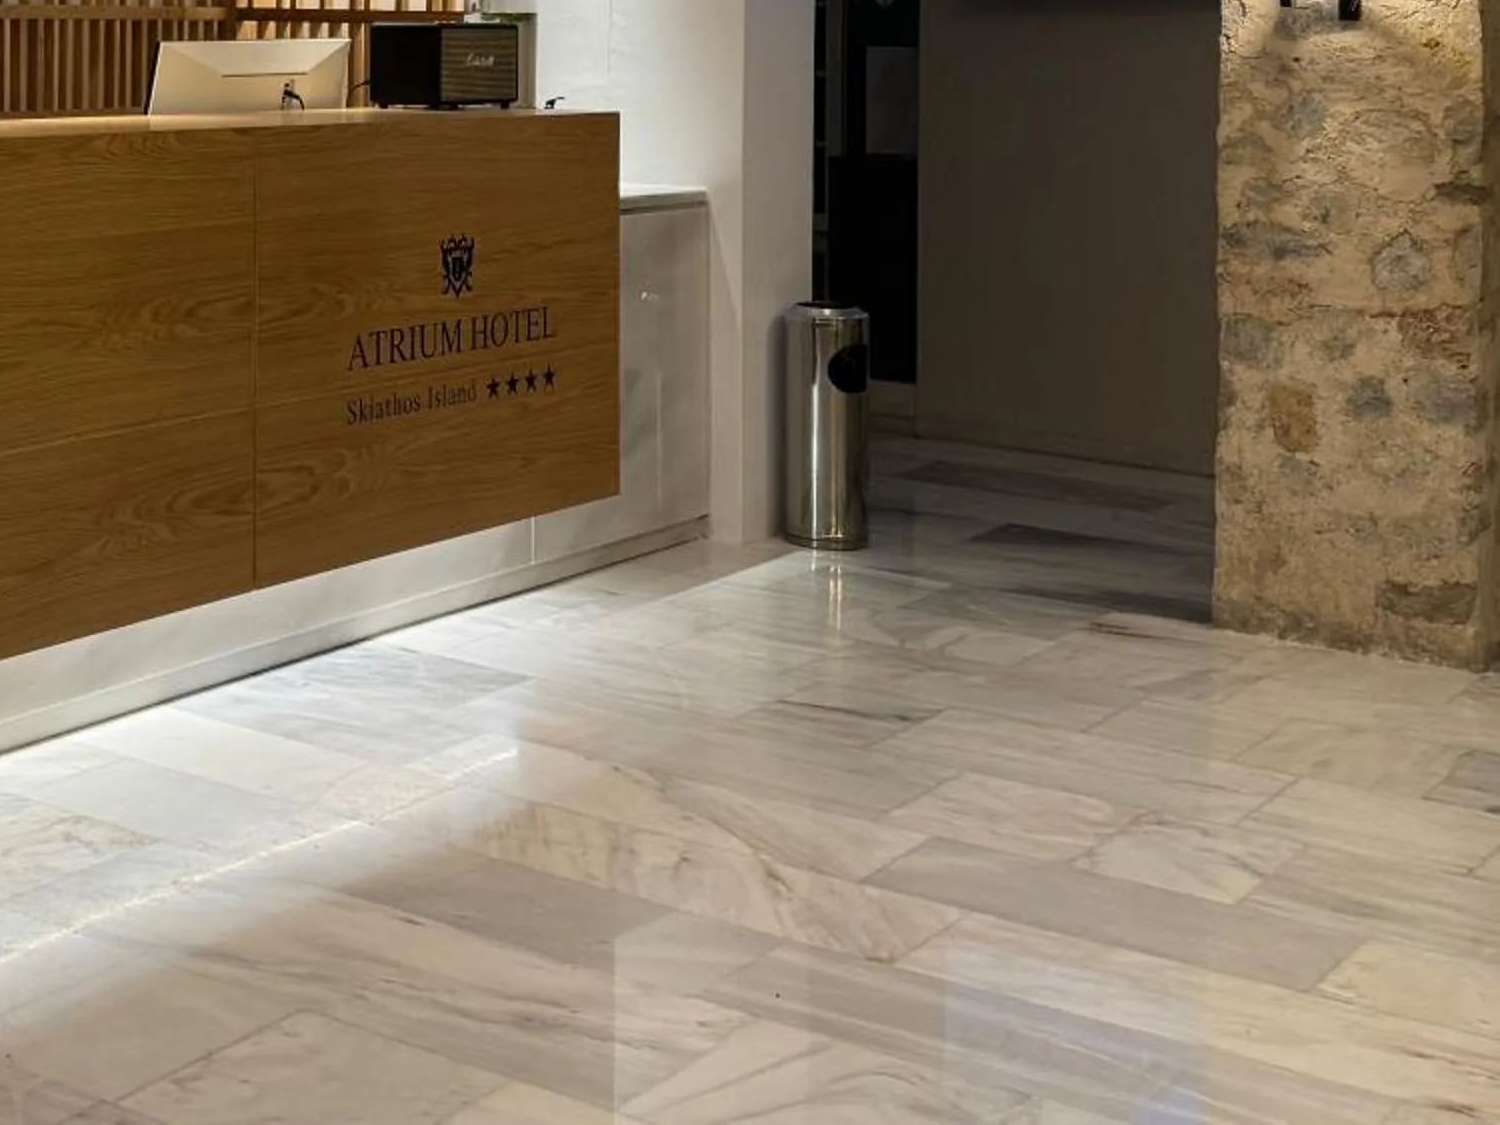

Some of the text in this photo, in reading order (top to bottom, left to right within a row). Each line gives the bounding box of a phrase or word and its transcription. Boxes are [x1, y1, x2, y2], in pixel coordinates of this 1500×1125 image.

[347, 305, 557, 372] ATRIUM HOTEL
[346, 378, 478, 425] Skiathos Island
